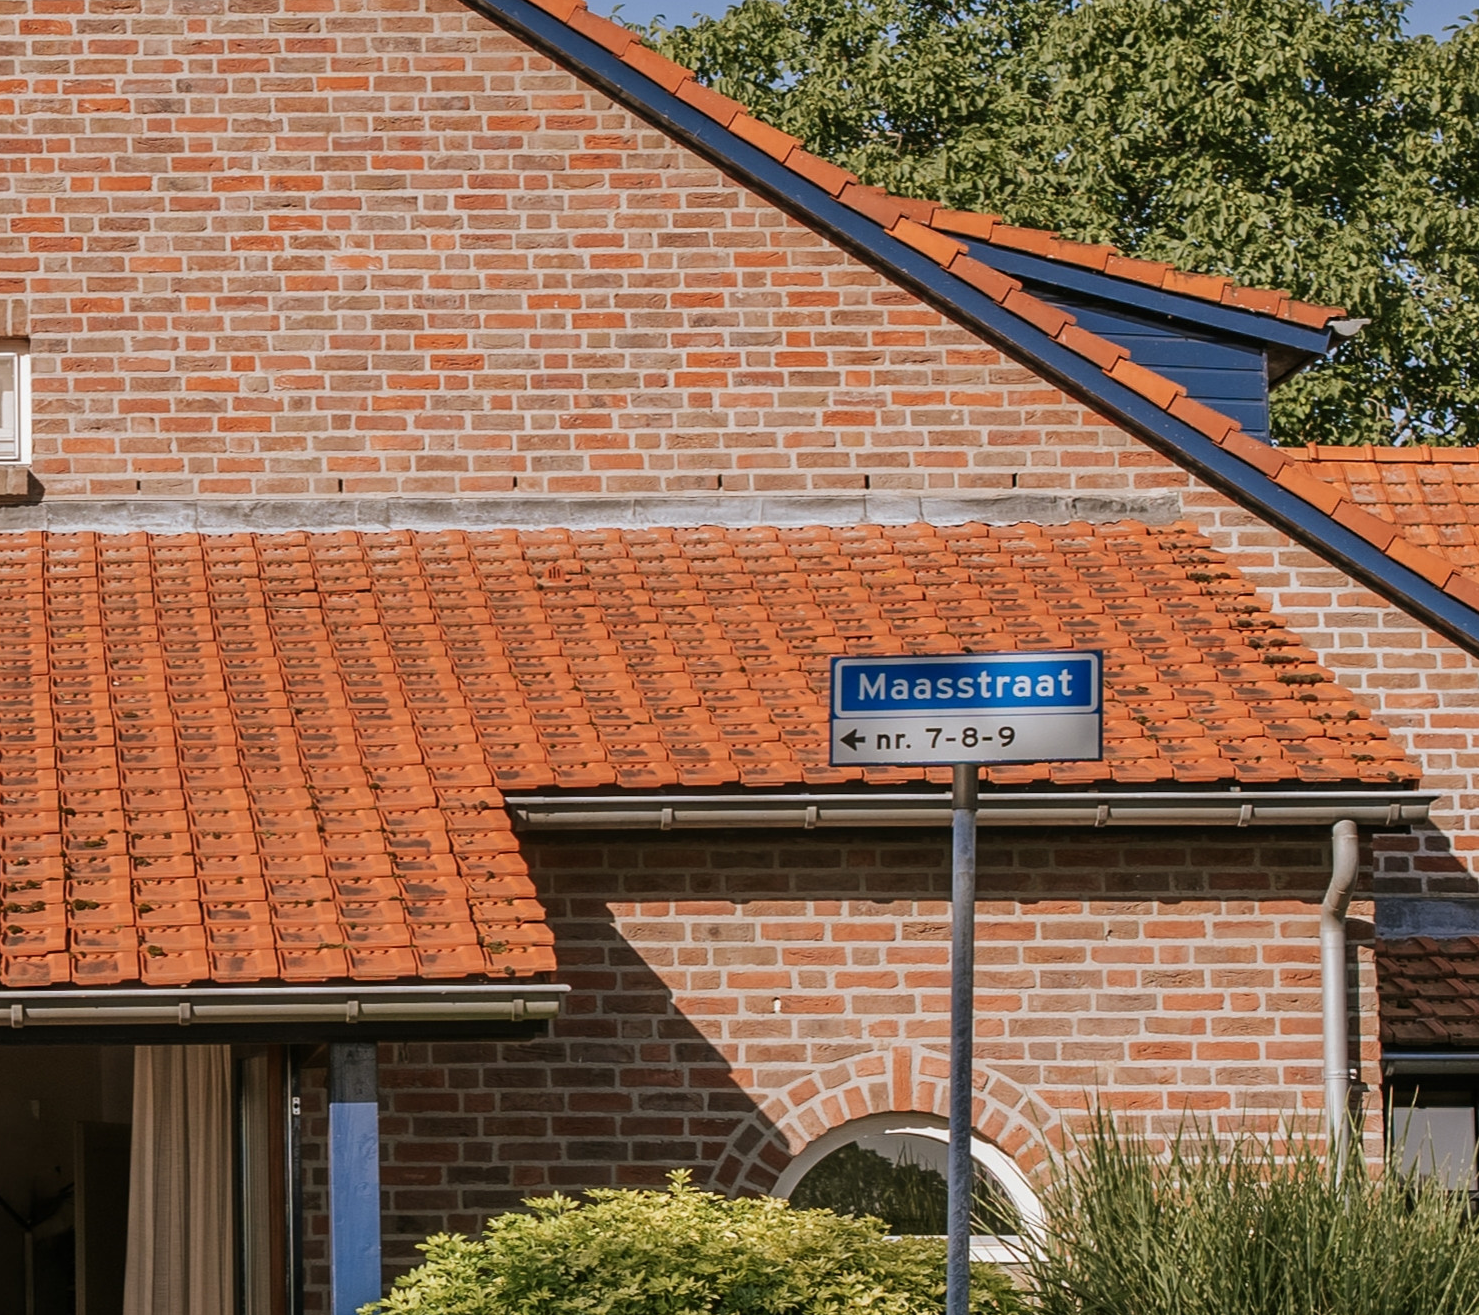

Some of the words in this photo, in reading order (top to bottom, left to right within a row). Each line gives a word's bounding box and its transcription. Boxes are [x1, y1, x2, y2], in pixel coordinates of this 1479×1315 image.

[857, 668, 1073, 701] Maasstraat
[876, 731, 912, 750] nr.
[925, 726, 1016, 749] 7-8-9
